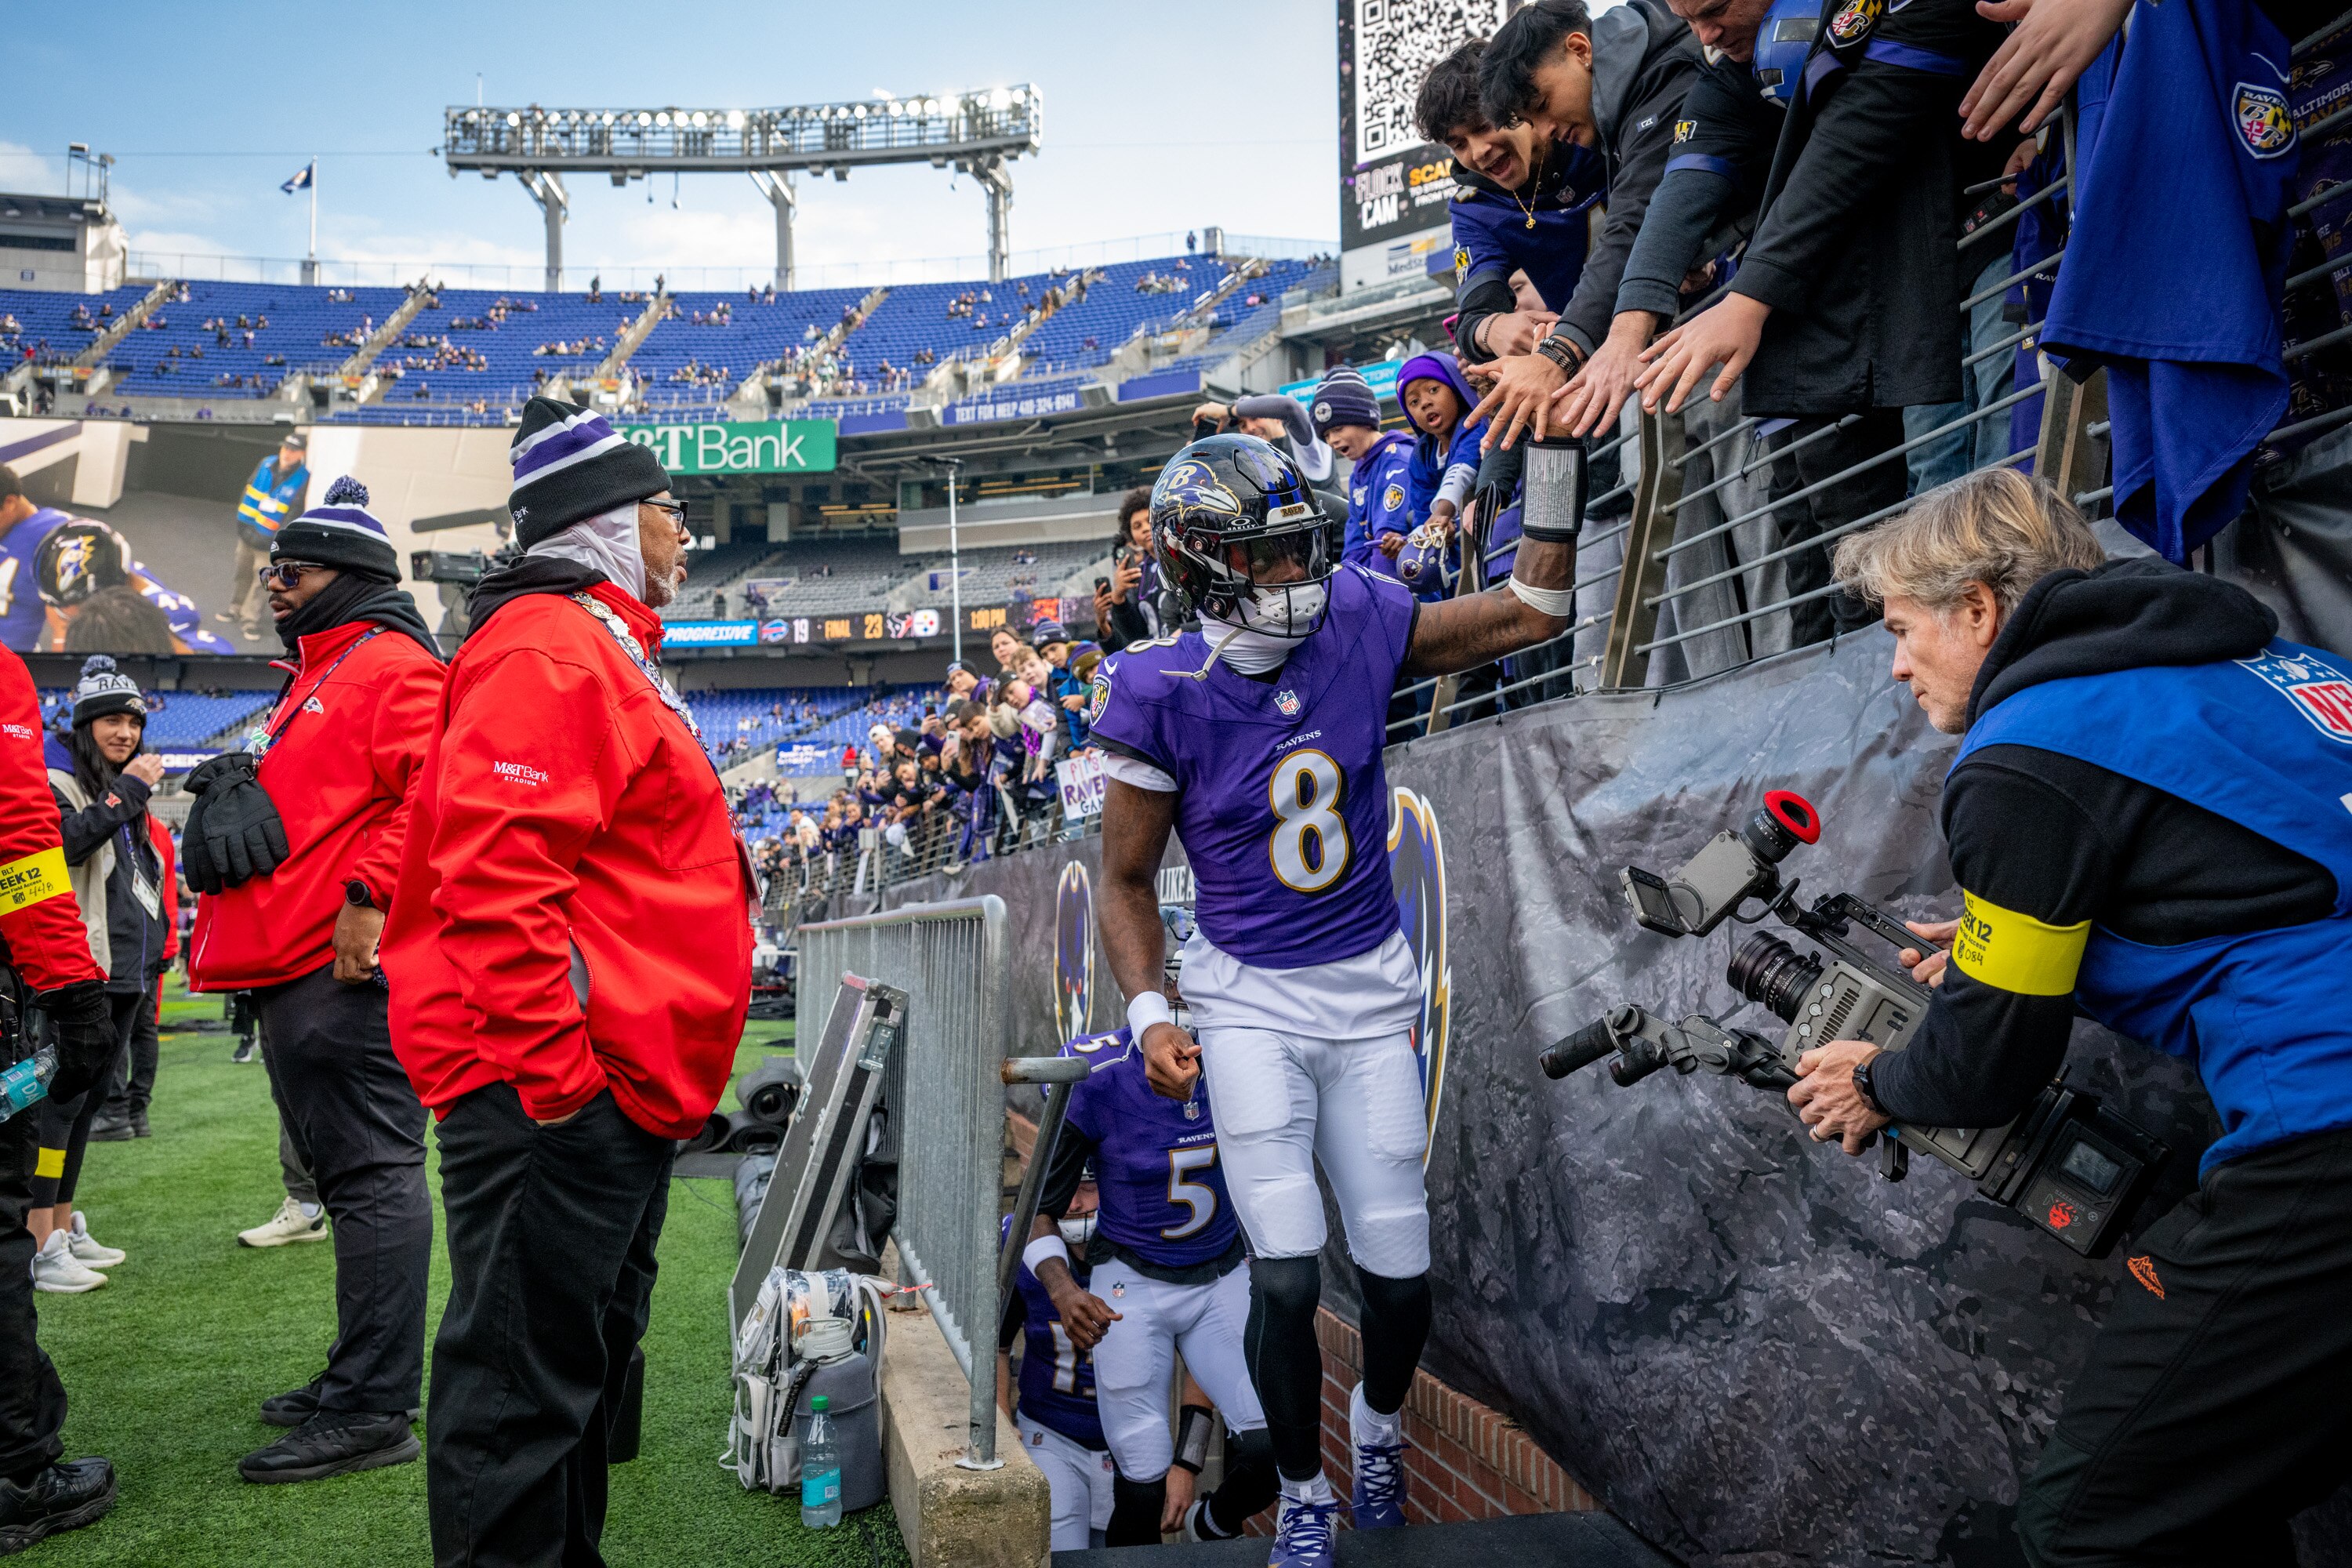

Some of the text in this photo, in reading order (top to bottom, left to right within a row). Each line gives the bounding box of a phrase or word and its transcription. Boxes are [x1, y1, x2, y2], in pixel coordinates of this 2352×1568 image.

[2292, 79, 2352, 119] ALTIMOR
[1355, 162, 1404, 204] FLOCK
[1361, 194, 1399, 230] CAM
[2034, 273, 2057, 282] RAV
[955, 405, 977, 423] TEXT
[978, 404, 996, 421] FOR
[996, 401, 1018, 419] HELP
[614, 423, 807, 470] &T Bank
[1281, 504, 1305, 517] RAVENS
[663, 624, 755, 643] PROGRESSIVE
[793, 613, 884, 644] 19 FINAL 23
[1281, 699, 1298, 712] NFL
[2294, 683, 2352, 733] NF
[2, 724, 21, 734] M&T
[1276, 729, 1322, 751] RAVENS
[492, 760, 550, 783] M&T Bank
[504, 775, 537, 786] STADIUM
[1064, 772, 1109, 806] RAVEN
[1268, 748, 1352, 894] 8
[0, 867, 42, 891] EEK 12
[1, 866, 14, 877] BLT
[24, 879, 42, 888] Access
[1159, 865, 1186, 904] LIKE
[1976, 919, 1993, 944] 12
[1965, 948, 1984, 967] 084
[1178, 1132, 1216, 1144] RAVENS
[1160, 1142, 1218, 1240] 5
[1048, 1320, 1098, 1398] 1
